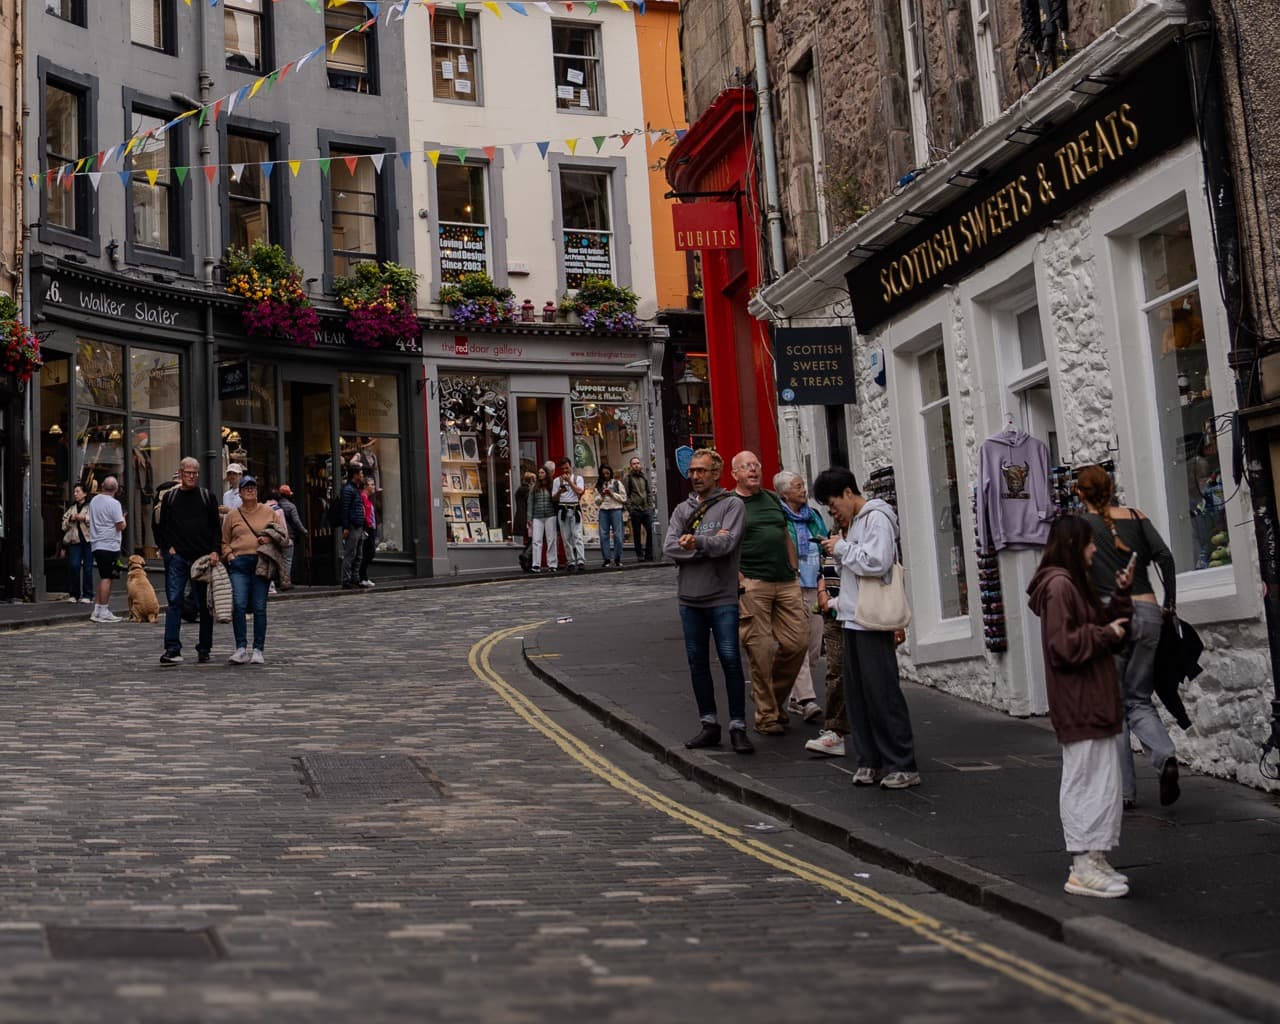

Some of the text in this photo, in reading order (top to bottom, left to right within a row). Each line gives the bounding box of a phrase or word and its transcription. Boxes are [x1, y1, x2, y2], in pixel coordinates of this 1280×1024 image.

[879, 103, 1139, 304] SCOTTISH SWEETS & TREATS
[440, 238, 483, 250] Loving Local
[678, 229, 737, 248] CUBITTS
[462, 250, 487, 262] Design
[441, 260, 482, 271] Since 2003
[79, 290, 180, 326] Walker Slater
[313, 328, 347, 346] WEAR
[441, 342, 523, 357] the red door gallery
[786, 344, 843, 356] SCOTTISH
[792, 360, 839, 372] SWEETS
[790, 376, 844, 387] & TREATS
[575, 384, 606, 392] SUPPORT
